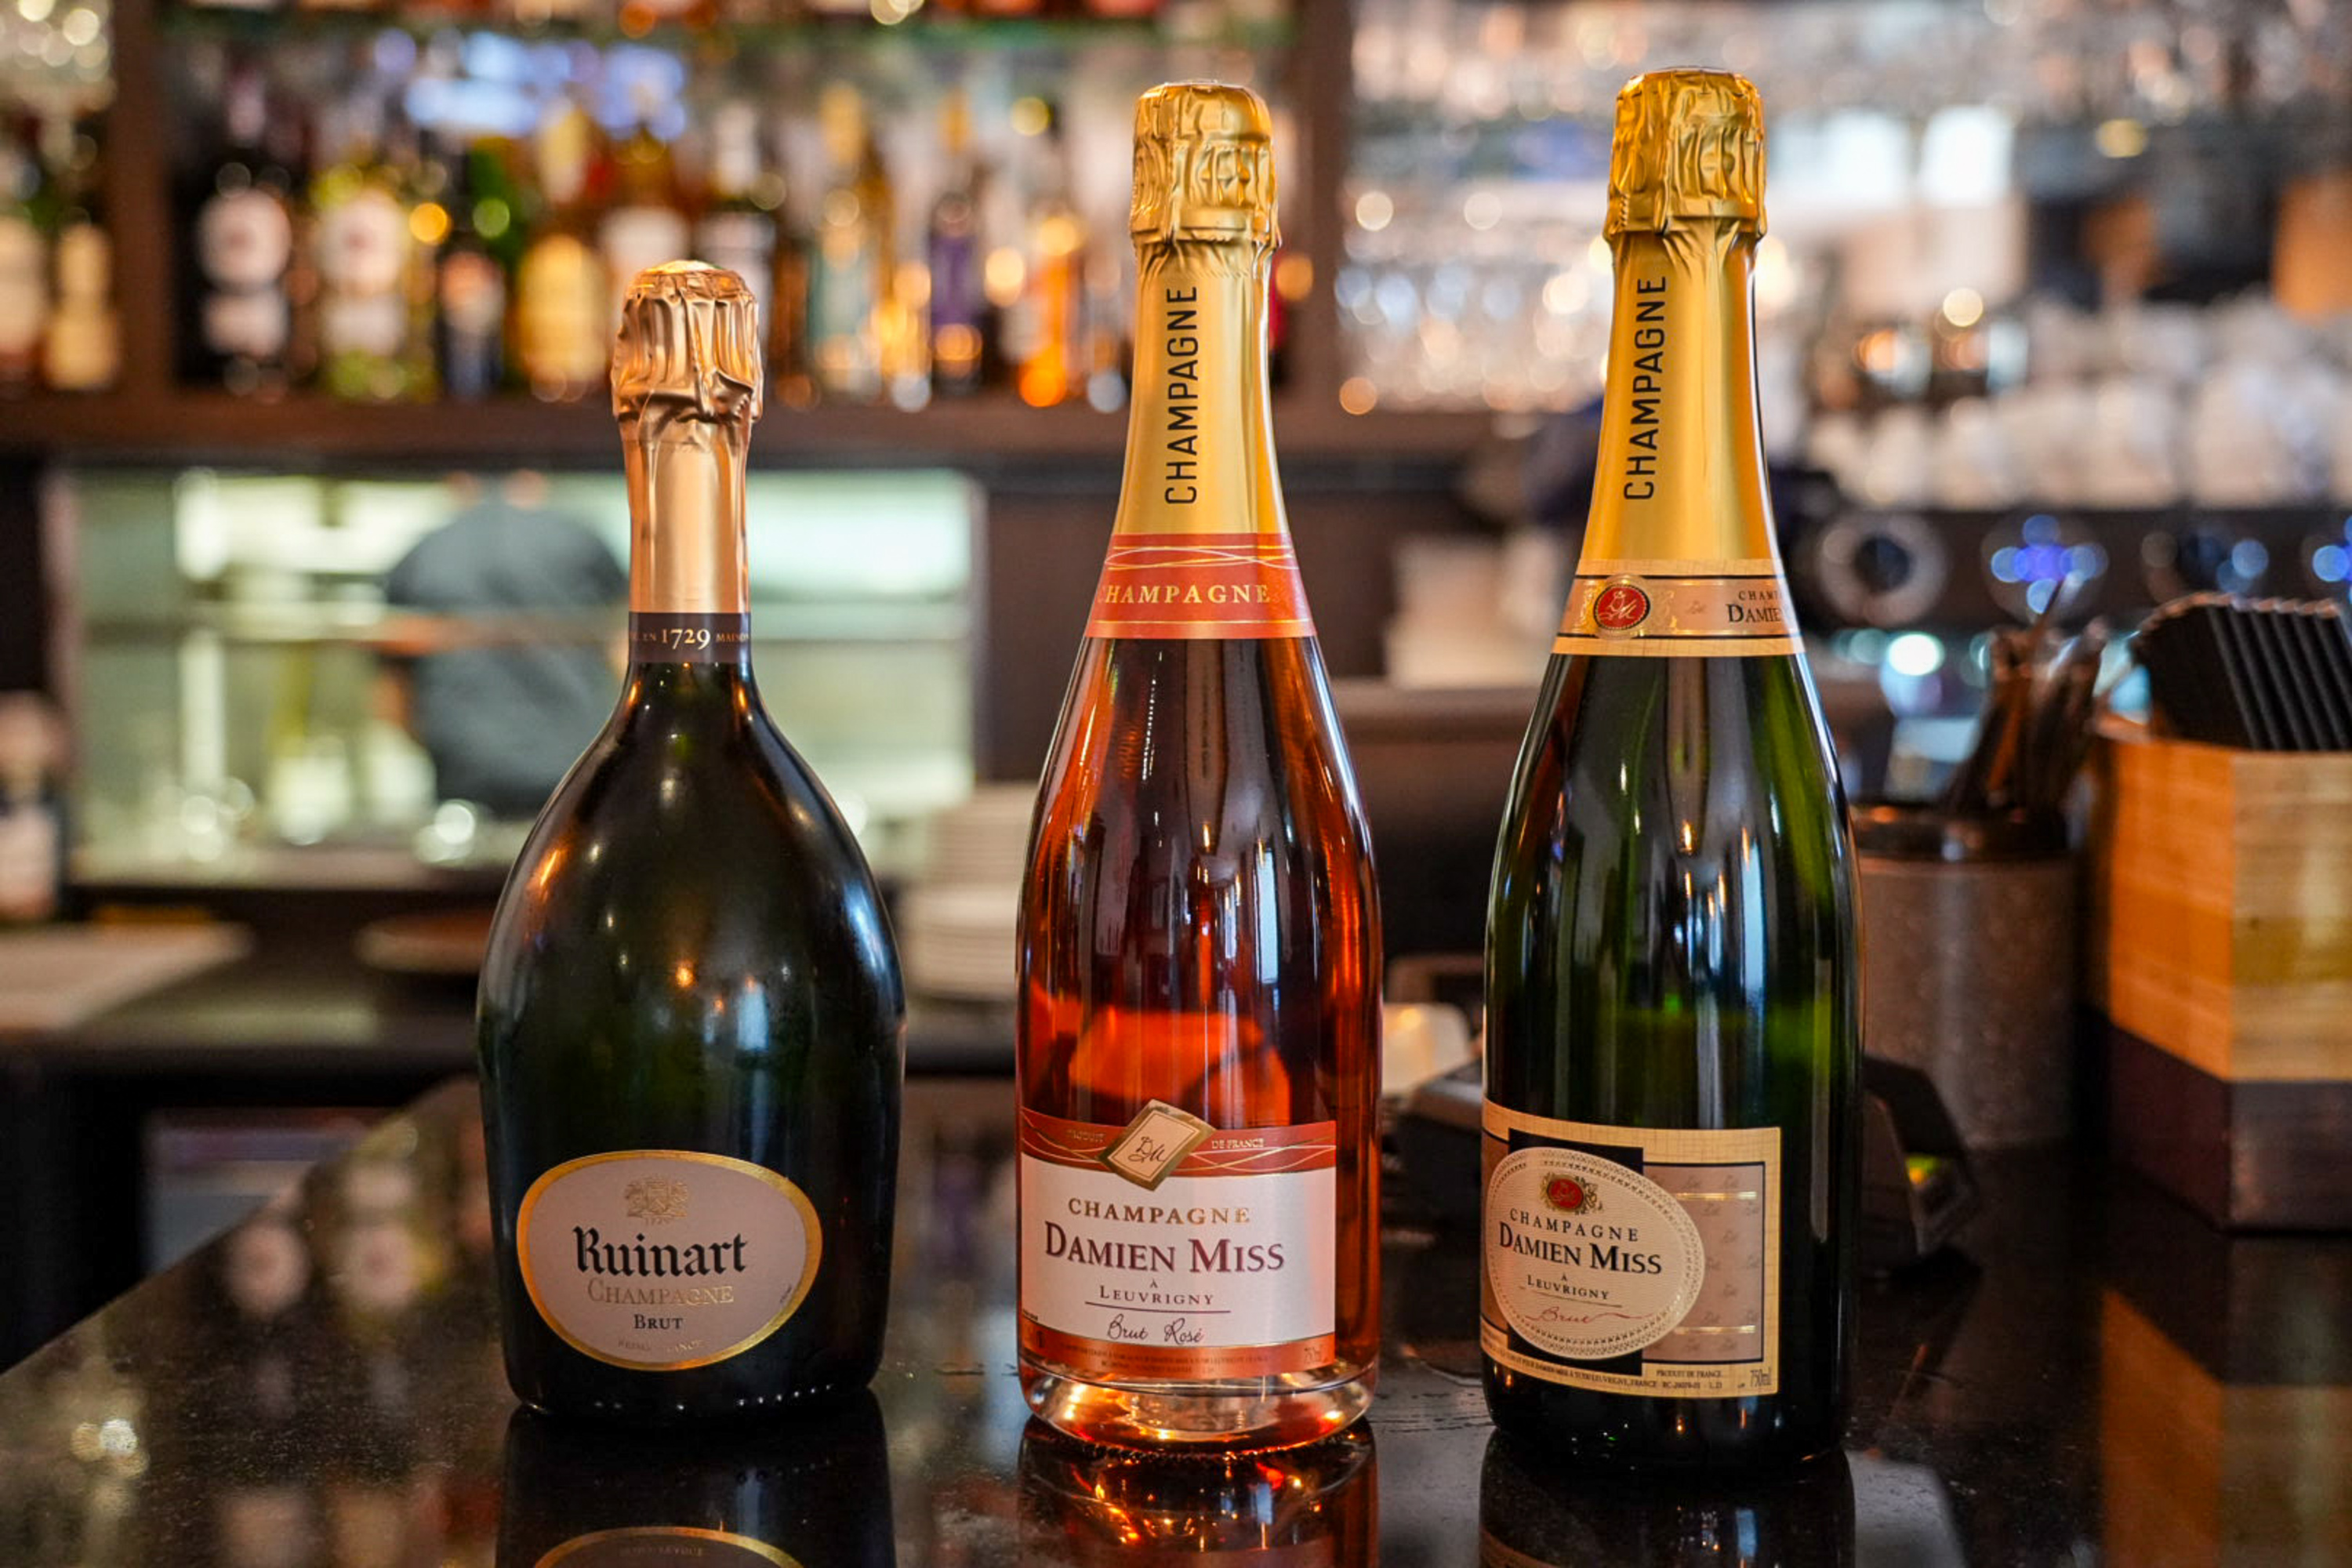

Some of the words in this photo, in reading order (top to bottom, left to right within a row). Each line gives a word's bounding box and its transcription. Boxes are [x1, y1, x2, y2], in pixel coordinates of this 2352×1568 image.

[1165, 286, 1199, 505] CHAMPAGNE
[1624, 276, 1667, 501] CHAMPAGNE
[662, 628, 711, 650] 1729
[1211, 1139, 1225, 1149] DE
[1227, 1138, 1265, 1149] FRANCE
[1068, 1197, 1250, 1225] CHAMPAGNE
[1509, 1207, 1639, 1243] CHAMPAGNE
[572, 1225, 748, 1277] Ruinart
[1044, 1220, 1175, 1272] DAMIEN
[1189, 1239, 1285, 1273] MISS
[1499, 1221, 1581, 1267] DAMIEN
[1590, 1242, 1663, 1276] MISS
[587, 1278, 735, 1306] CHAMPAGNE
[1099, 1285, 1215, 1305] LEUVRIGNY
[1526, 1275, 1610, 1301] LEUVRIGNY
[633, 1315, 683, 1330] BRUT
[1106, 1313, 1149, 1340] Brut
[1163, 1317, 1205, 1345] Rosé
